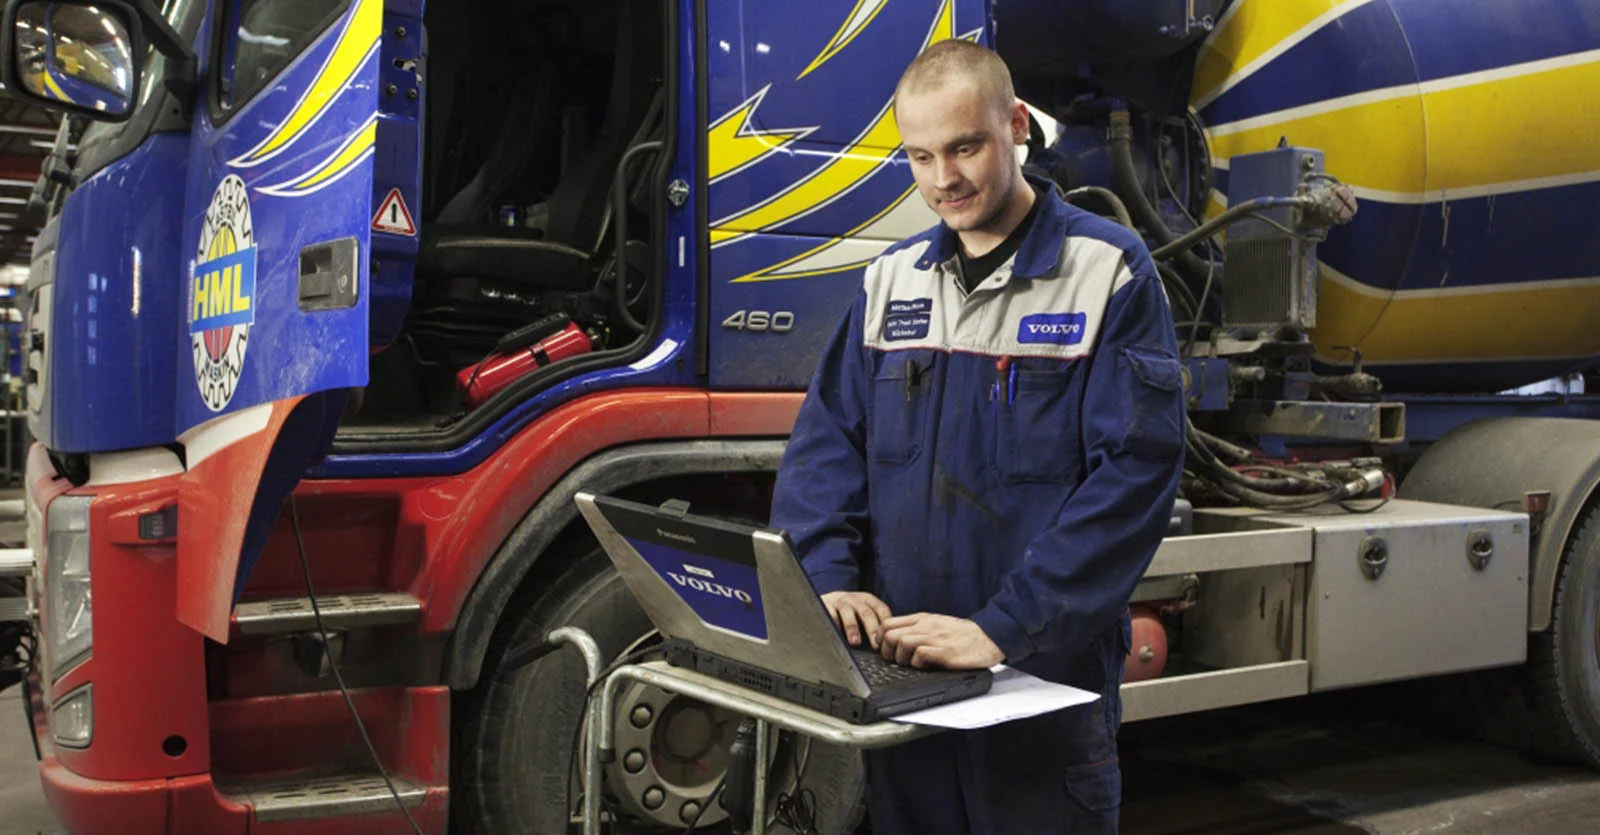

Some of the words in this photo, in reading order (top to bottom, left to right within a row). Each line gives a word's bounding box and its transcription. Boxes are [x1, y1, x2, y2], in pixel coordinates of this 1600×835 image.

[193, 263, 250, 320] HML
[722, 309, 794, 331] 460
[1027, 323, 1080, 335] VOLVO
[666, 571, 753, 604] VOLVO
